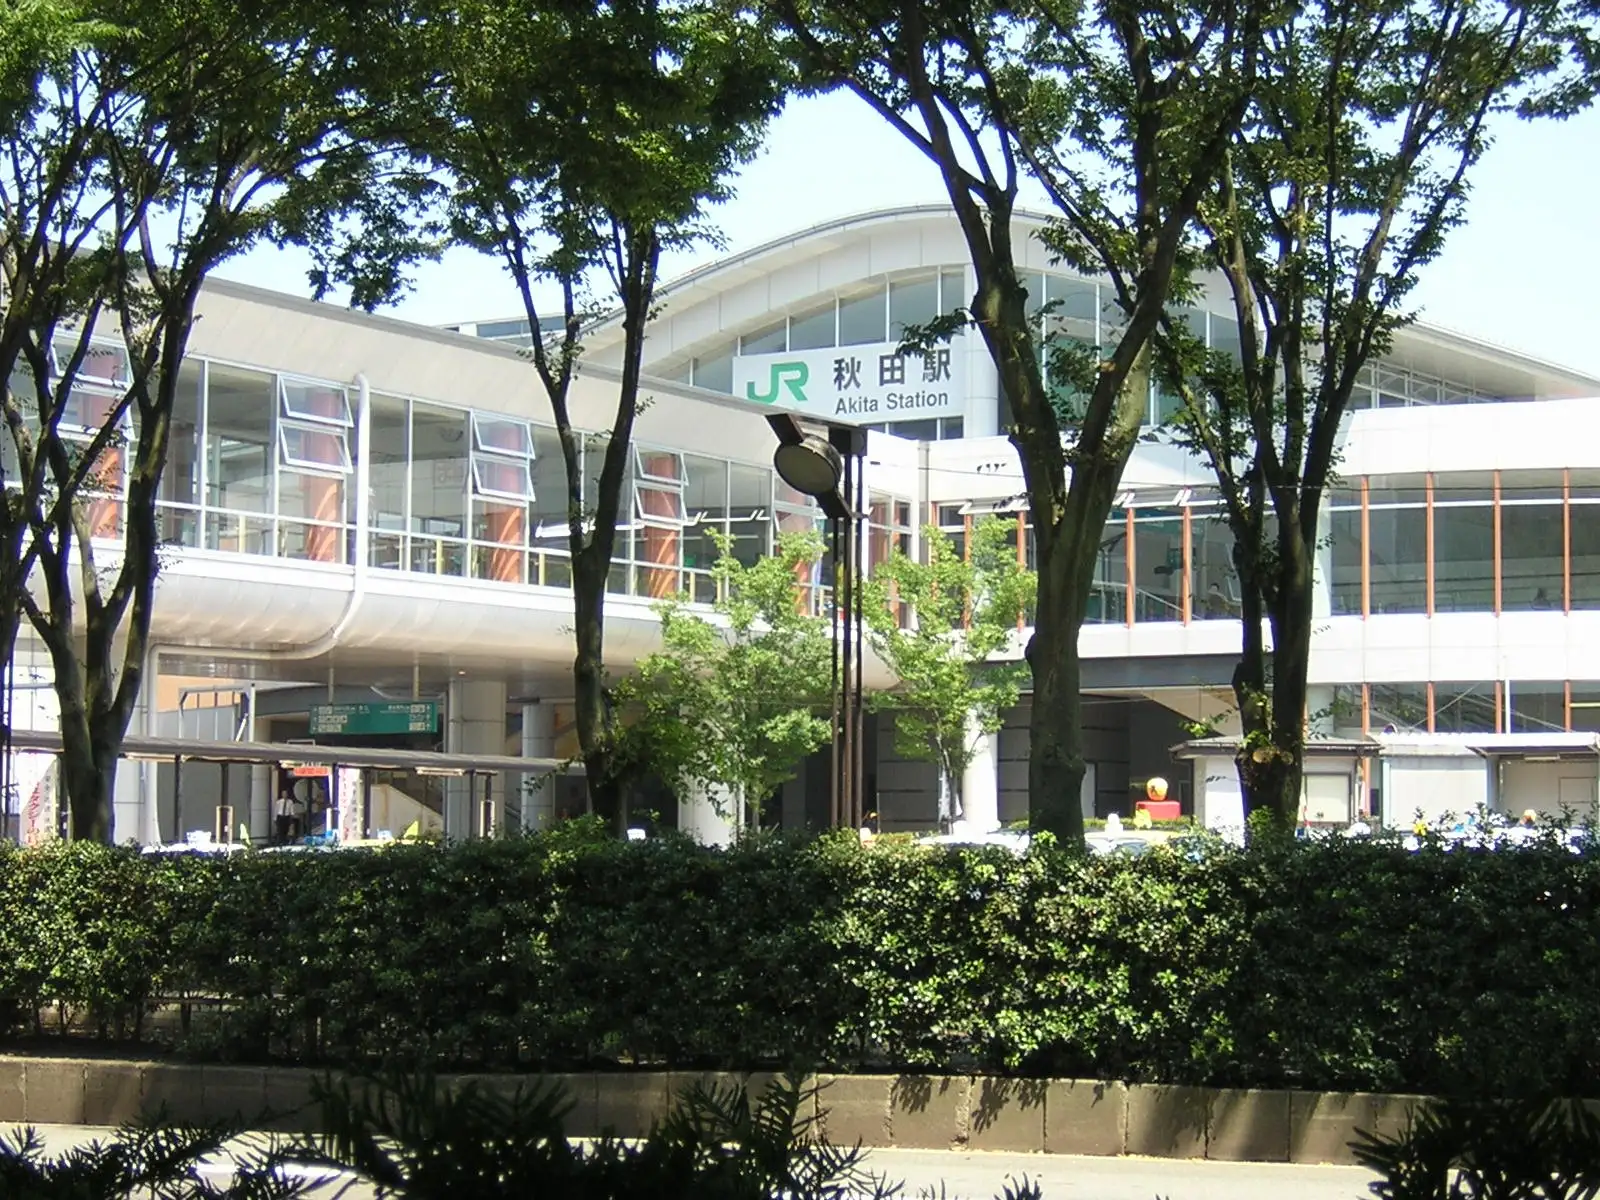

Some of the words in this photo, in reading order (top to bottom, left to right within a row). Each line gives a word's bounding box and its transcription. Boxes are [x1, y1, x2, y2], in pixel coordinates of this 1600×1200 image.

[747, 361, 809, 404] JR
[833, 349, 951, 391] 秋田駅
[835, 397, 879, 415] Akita
[886, 390, 948, 410] Station
